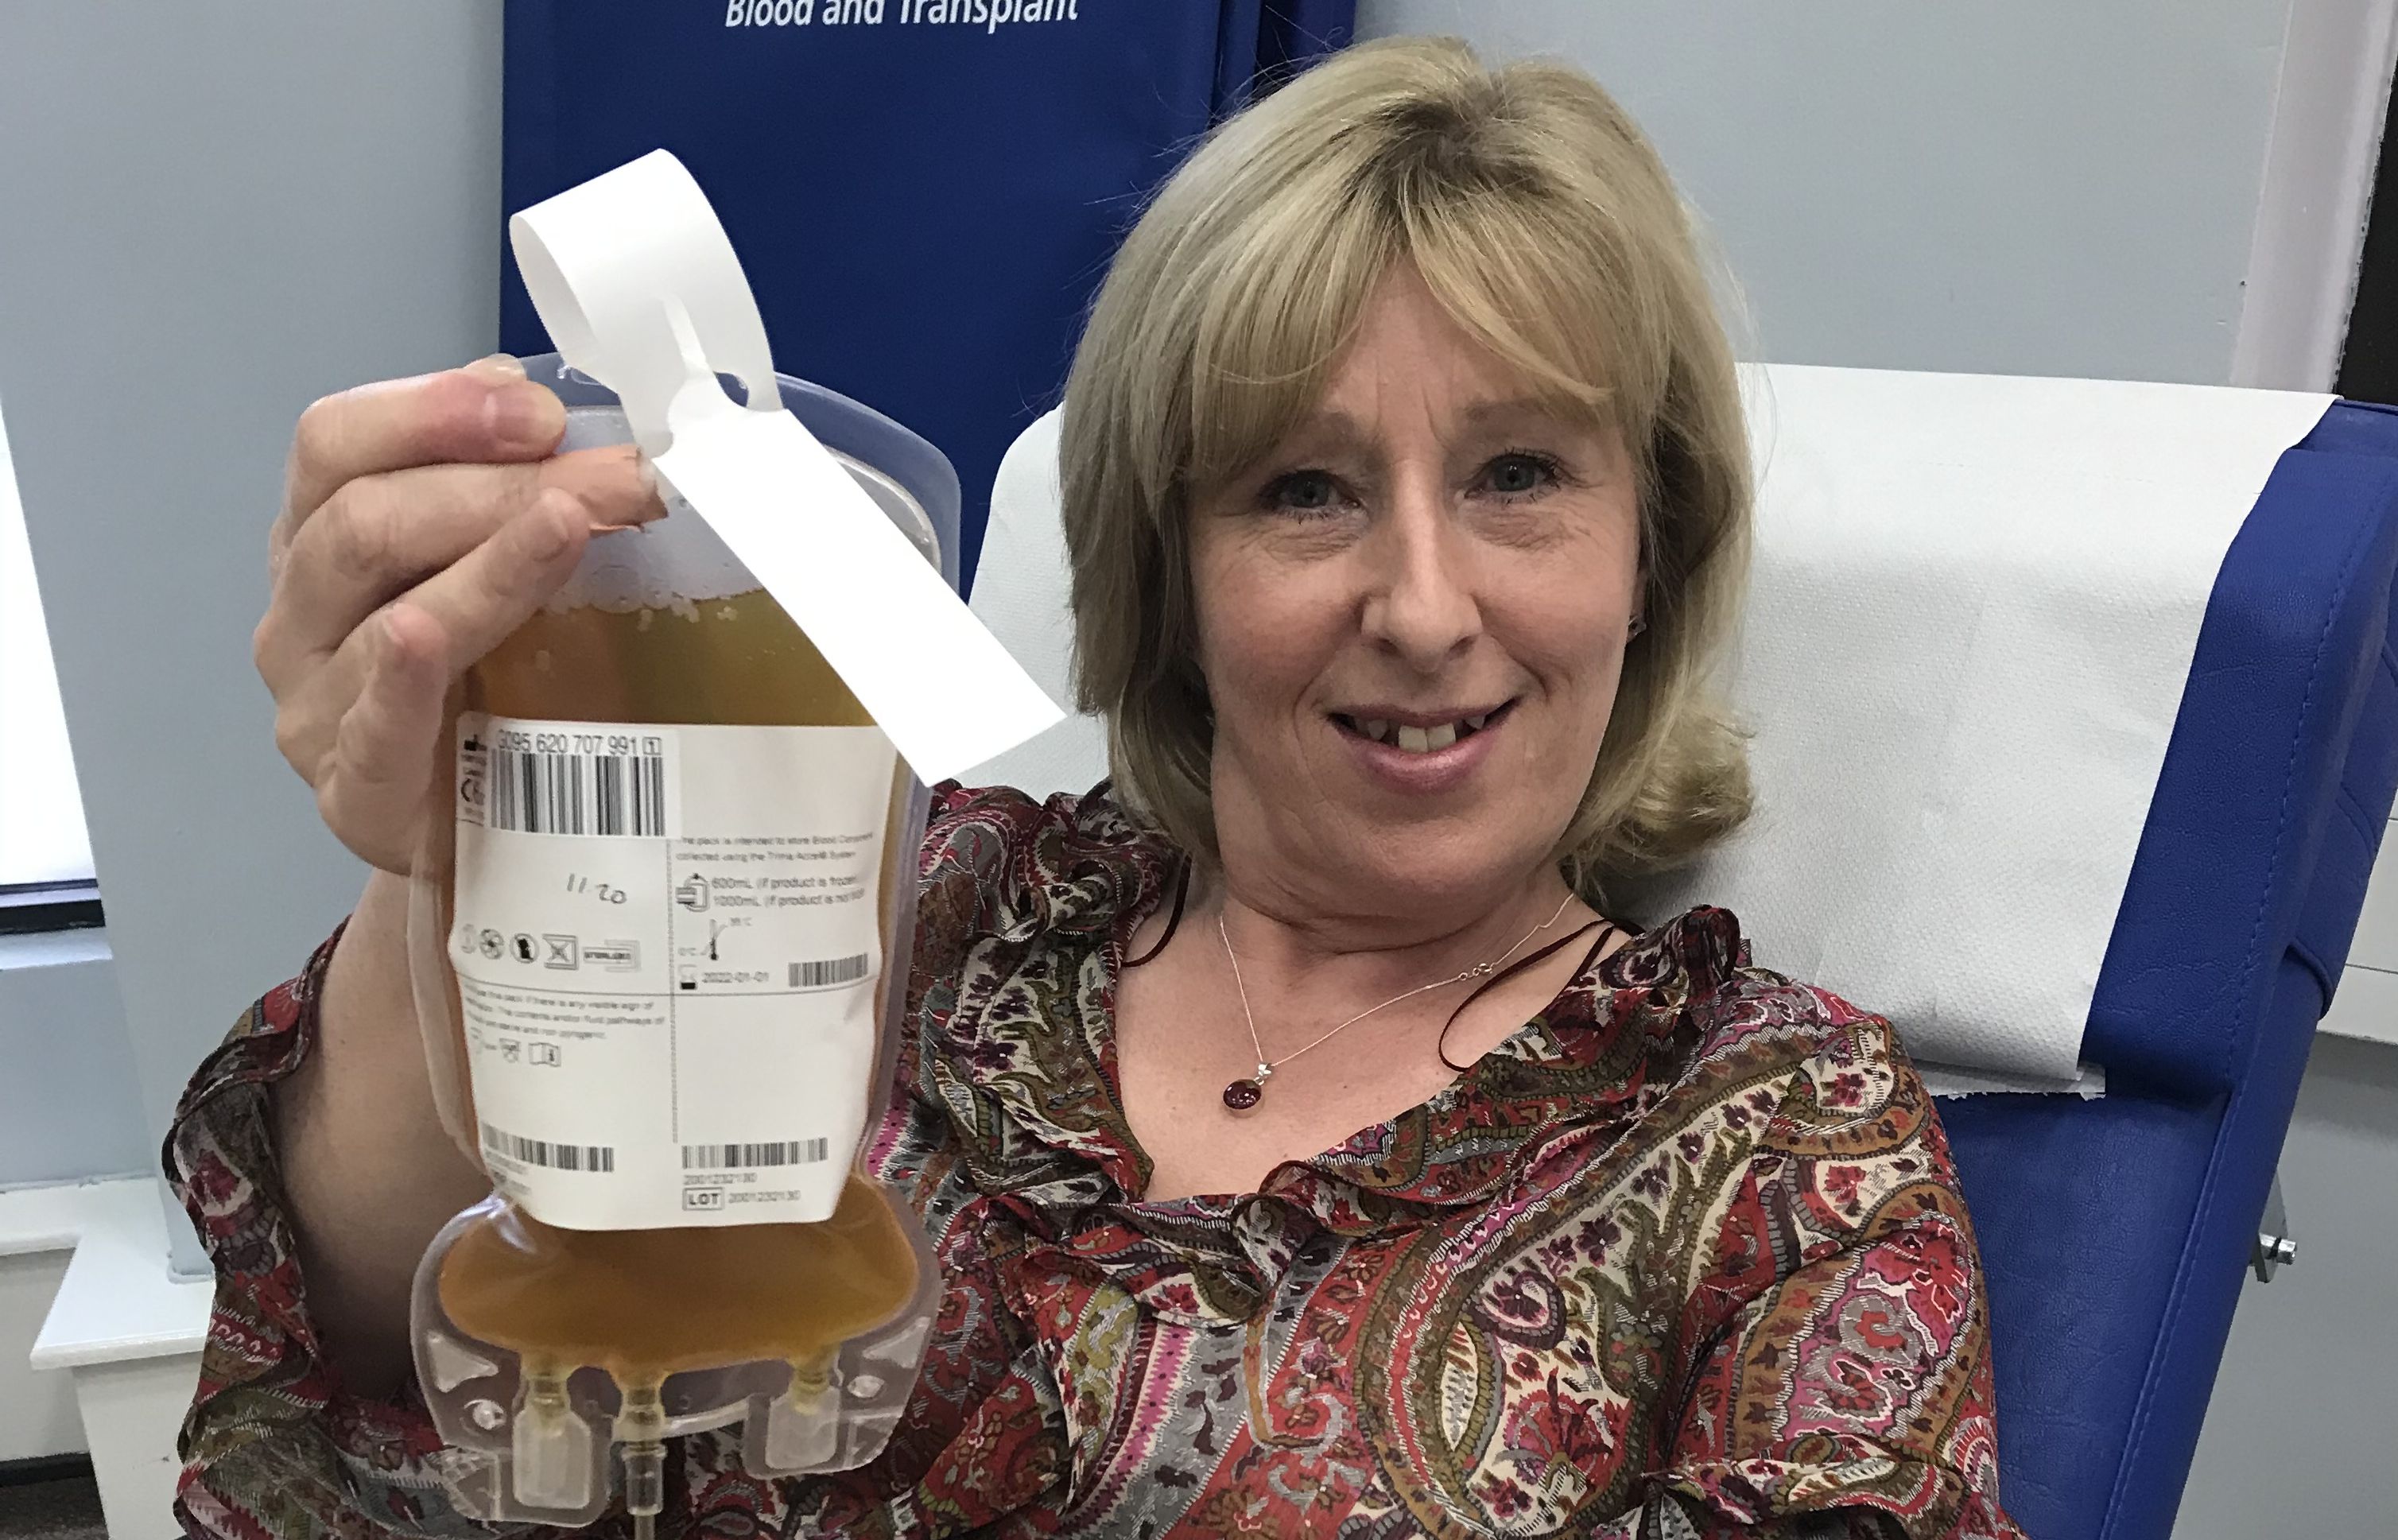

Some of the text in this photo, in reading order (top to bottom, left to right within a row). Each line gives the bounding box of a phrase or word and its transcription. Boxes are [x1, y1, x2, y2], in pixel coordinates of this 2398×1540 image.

[725, 0, 1079, 34] Blood and Transplant
[536, 733, 568, 754] 620
[572, 735, 603, 754] 707
[607, 735, 637, 755] 991
[688, 1193, 720, 1205] LOT
